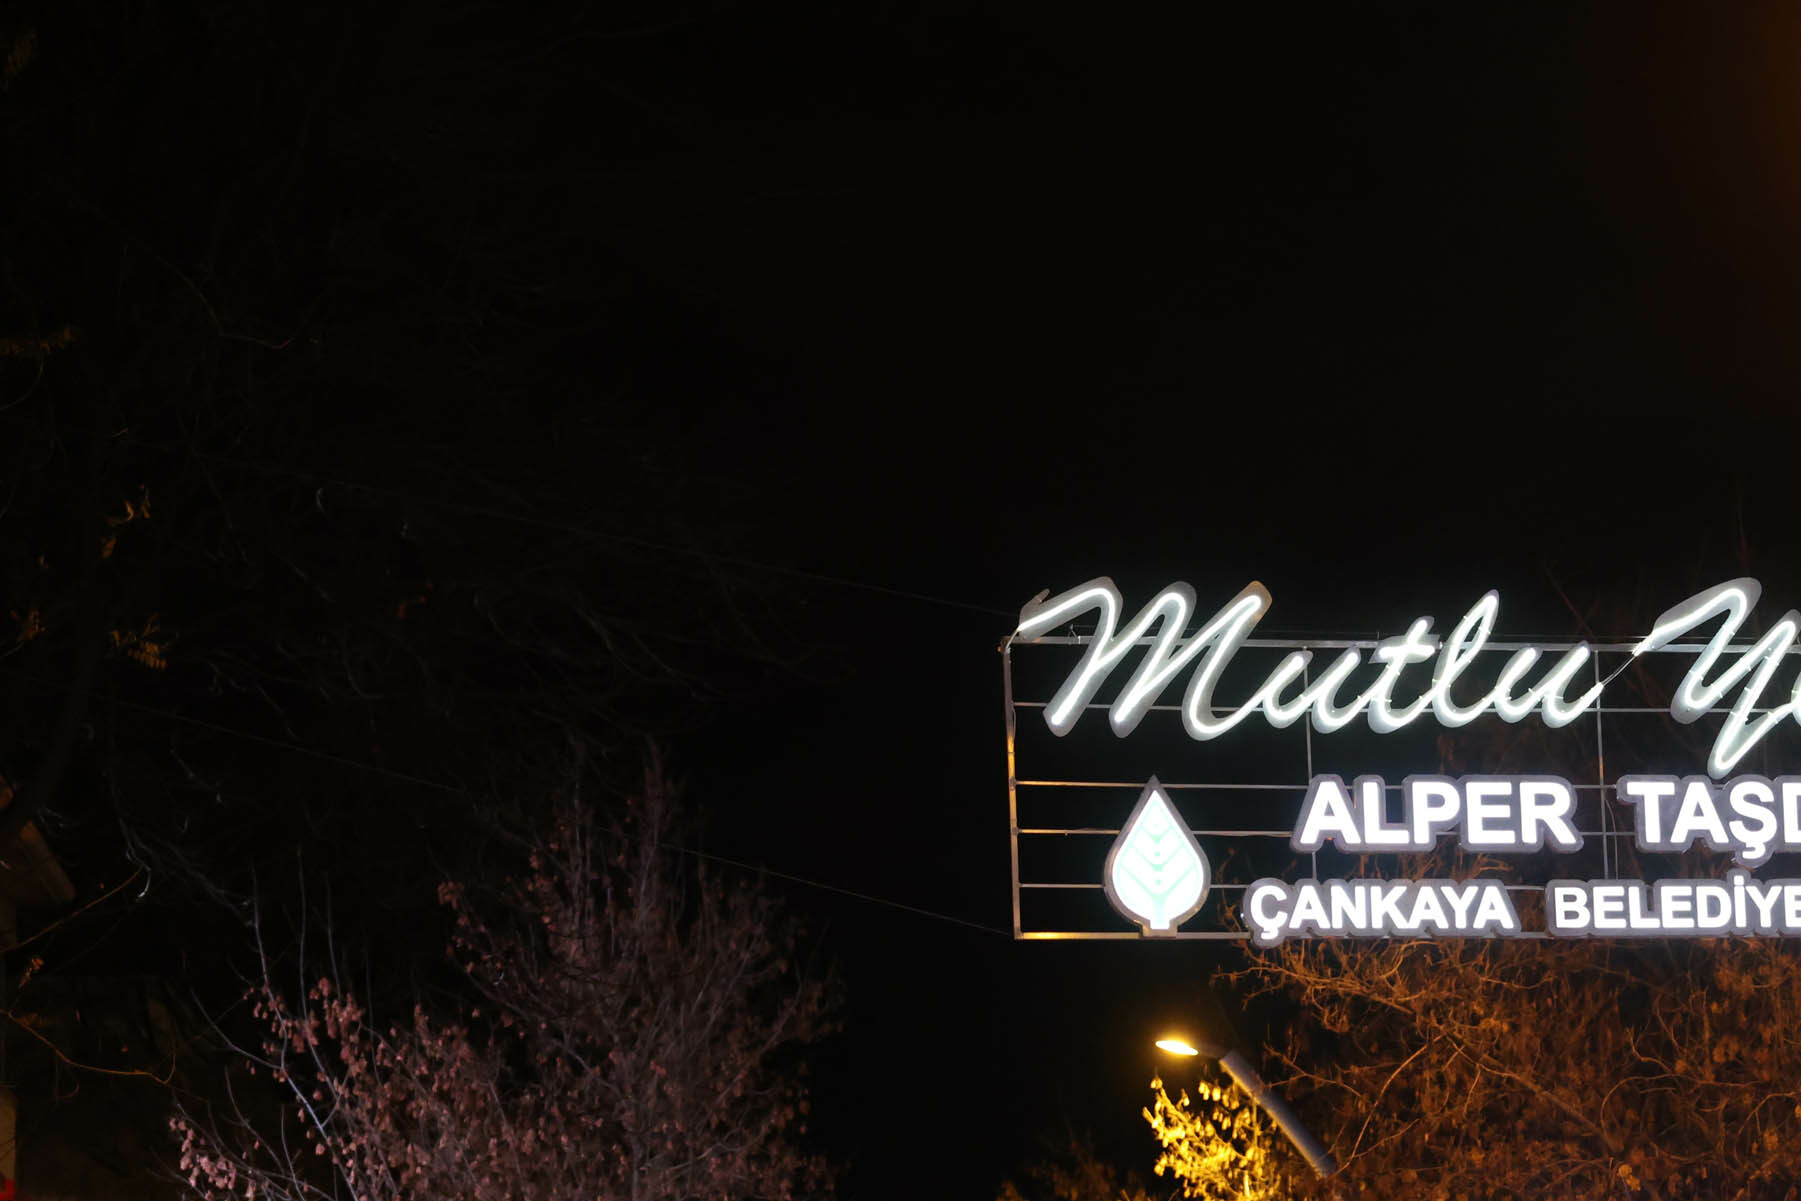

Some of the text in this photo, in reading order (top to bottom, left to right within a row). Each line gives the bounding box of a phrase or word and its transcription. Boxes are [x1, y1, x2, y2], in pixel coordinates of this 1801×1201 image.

[1014, 578, 1603, 738] Mutlu
[1298, 780, 1577, 846] ALPER
[1249, 884, 1515, 943] ÇANKAYA
